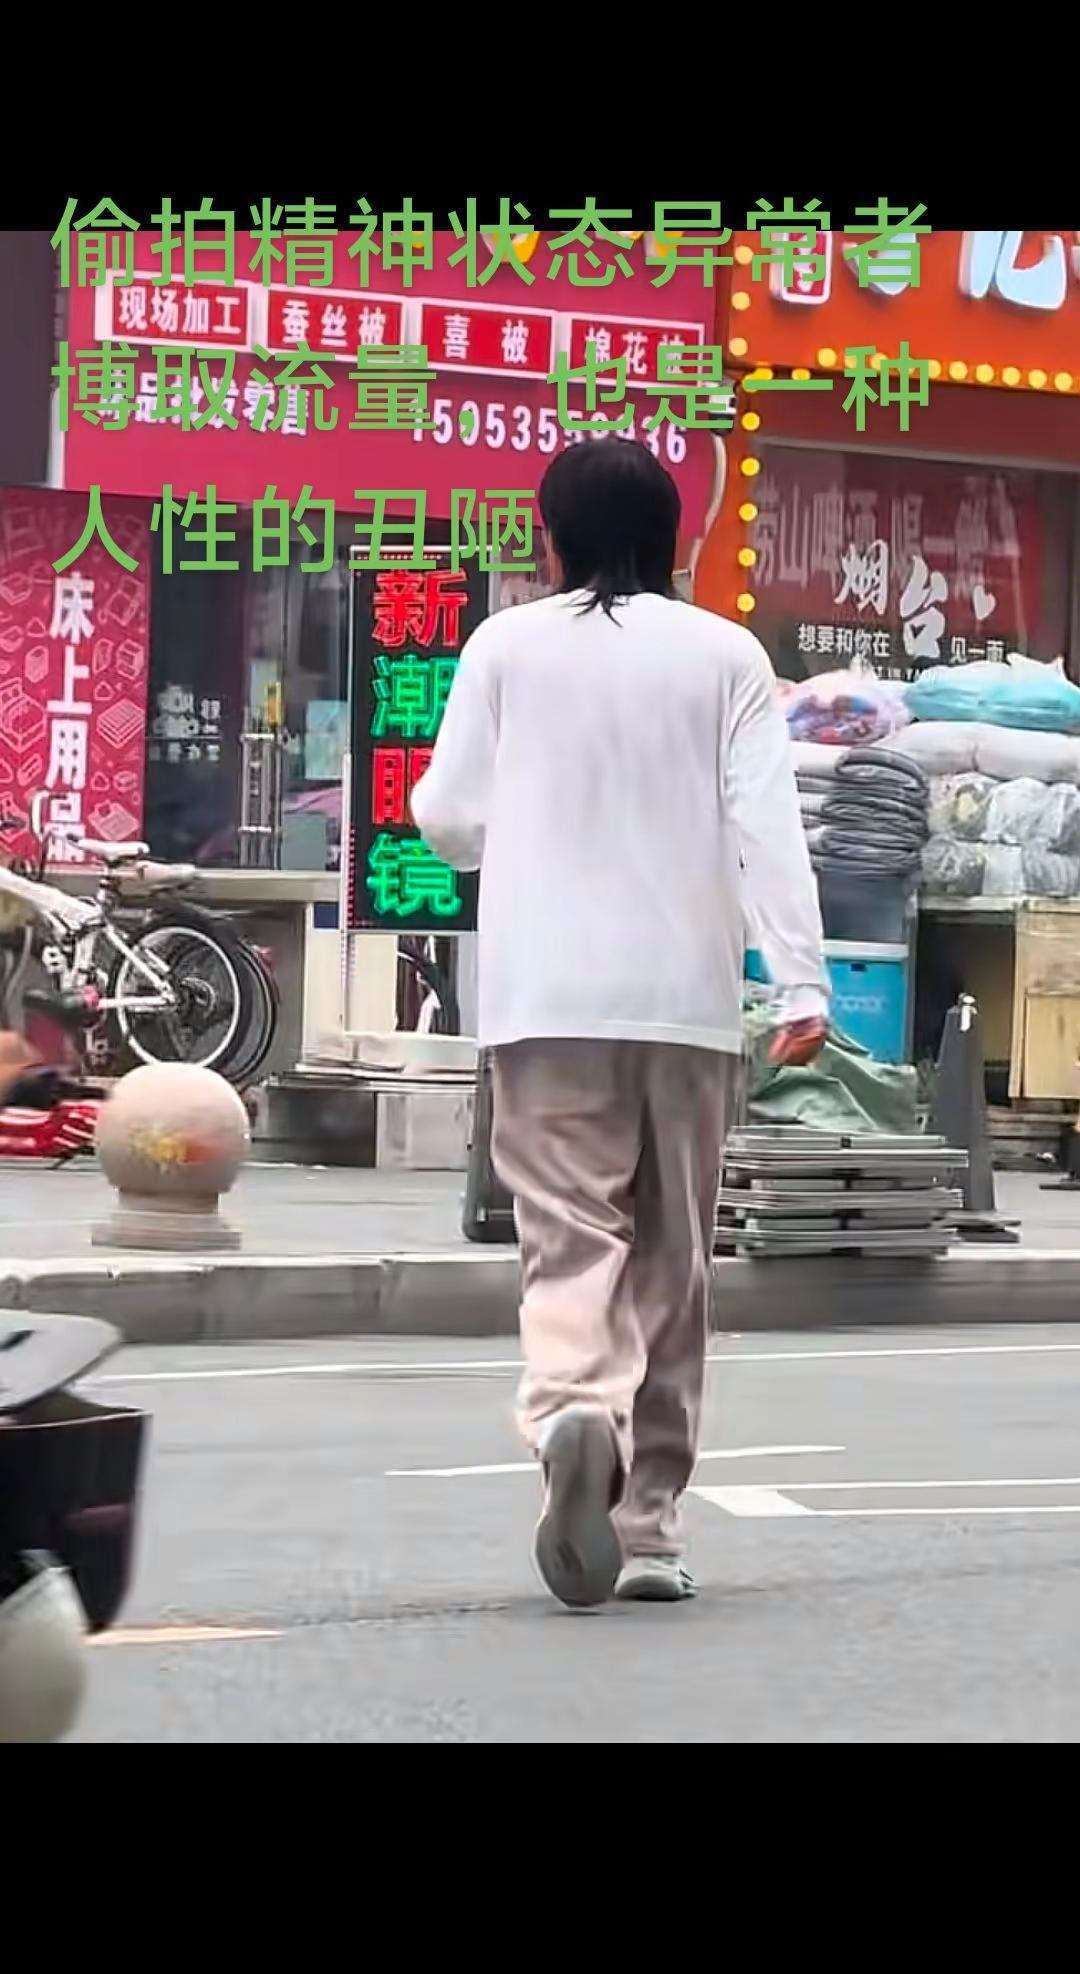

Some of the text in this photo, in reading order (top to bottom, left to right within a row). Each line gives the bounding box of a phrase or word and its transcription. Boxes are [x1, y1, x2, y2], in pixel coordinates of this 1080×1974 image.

[118, 285, 242, 336] 现场加工
[281, 299, 387, 347] 蚕丝被
[798, 624, 890, 659] 想要和你在
[45, 571, 96, 863] 床上用品
